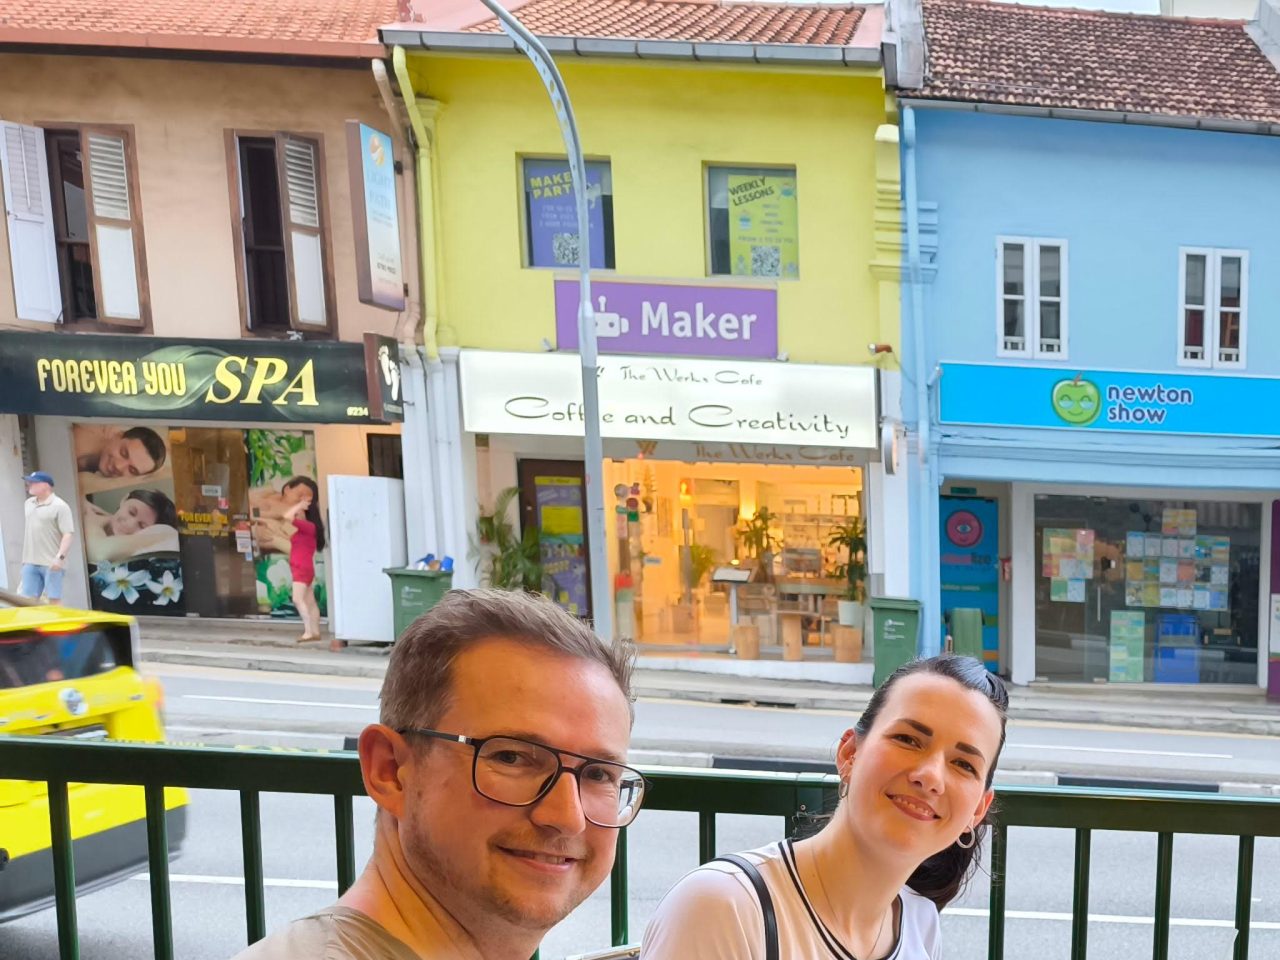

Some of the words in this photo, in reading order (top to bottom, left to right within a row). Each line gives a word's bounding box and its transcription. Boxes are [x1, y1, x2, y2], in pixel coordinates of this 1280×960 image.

[530, 171, 573, 188] MAKE
[729, 176, 766, 196] WEEKLY
[533, 183, 572, 199] PART
[733, 186, 775, 206] LESSONS
[641, 301, 757, 340] Maker
[37, 359, 138, 395] FOREVER
[141, 360, 186, 397] YOU
[205, 356, 320, 406] SPA
[620, 366, 646, 381] The
[714, 370, 763, 386] Cafe
[1107, 384, 1193, 404] newton
[504, 396, 614, 424] Coffe
[624, 406, 676, 427] and
[688, 404, 850, 440] Creativity
[1107, 402, 1166, 423] show
